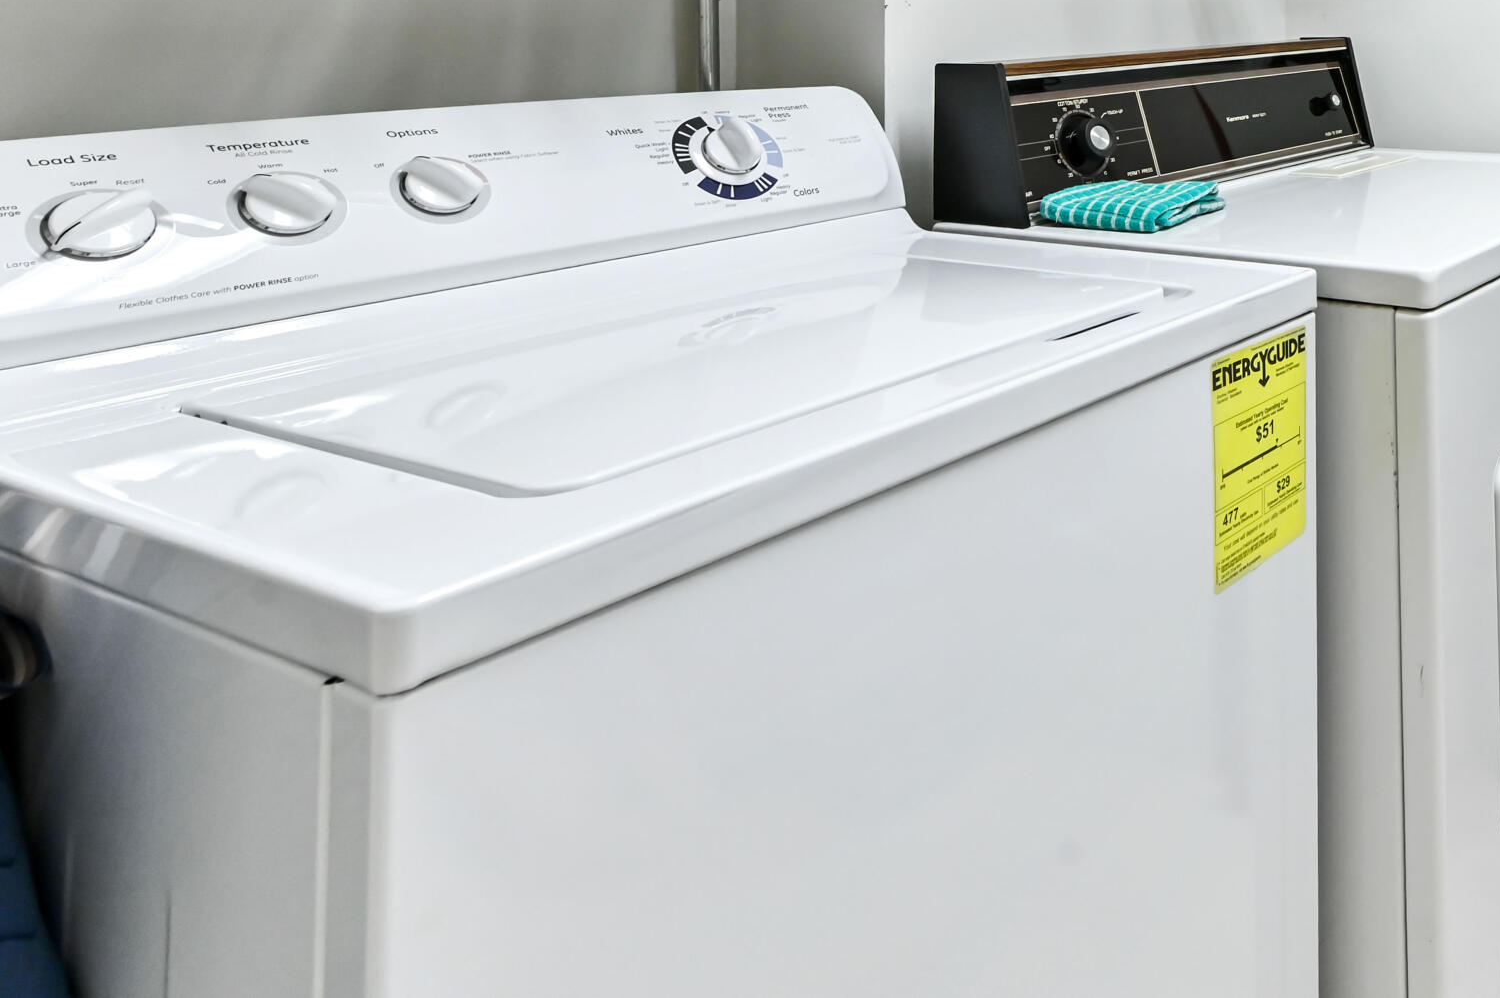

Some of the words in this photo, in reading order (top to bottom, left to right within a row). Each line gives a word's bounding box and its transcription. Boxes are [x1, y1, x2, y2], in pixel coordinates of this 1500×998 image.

[763, 103, 809, 113] Permanent
[386, 128, 439, 138] Options
[606, 127, 644, 137] Whites
[206, 138, 310, 153] Temperature
[247, 149, 268, 157] Cold
[27, 155, 76, 167] Load
[80, 153, 117, 163] Size
[258, 162, 283, 170] Warm
[115, 178, 145, 186] Reset
[793, 186, 820, 197] Colors
[6, 260, 37, 269] Large
[118, 299, 153, 310] Flexible
[155, 294, 189, 304] Clothes
[191, 290, 211, 299] Care
[213, 286, 232, 294] with
[233, 280, 266, 291] POWER
[268, 276, 292, 286] RINSE
[294, 273, 319, 282] option
[1212, 332, 1306, 392] ENERGYGUIDE
[1255, 418, 1275, 444] $51
[1276, 474, 1291, 495] $29
[1222, 506, 1240, 527] 477
